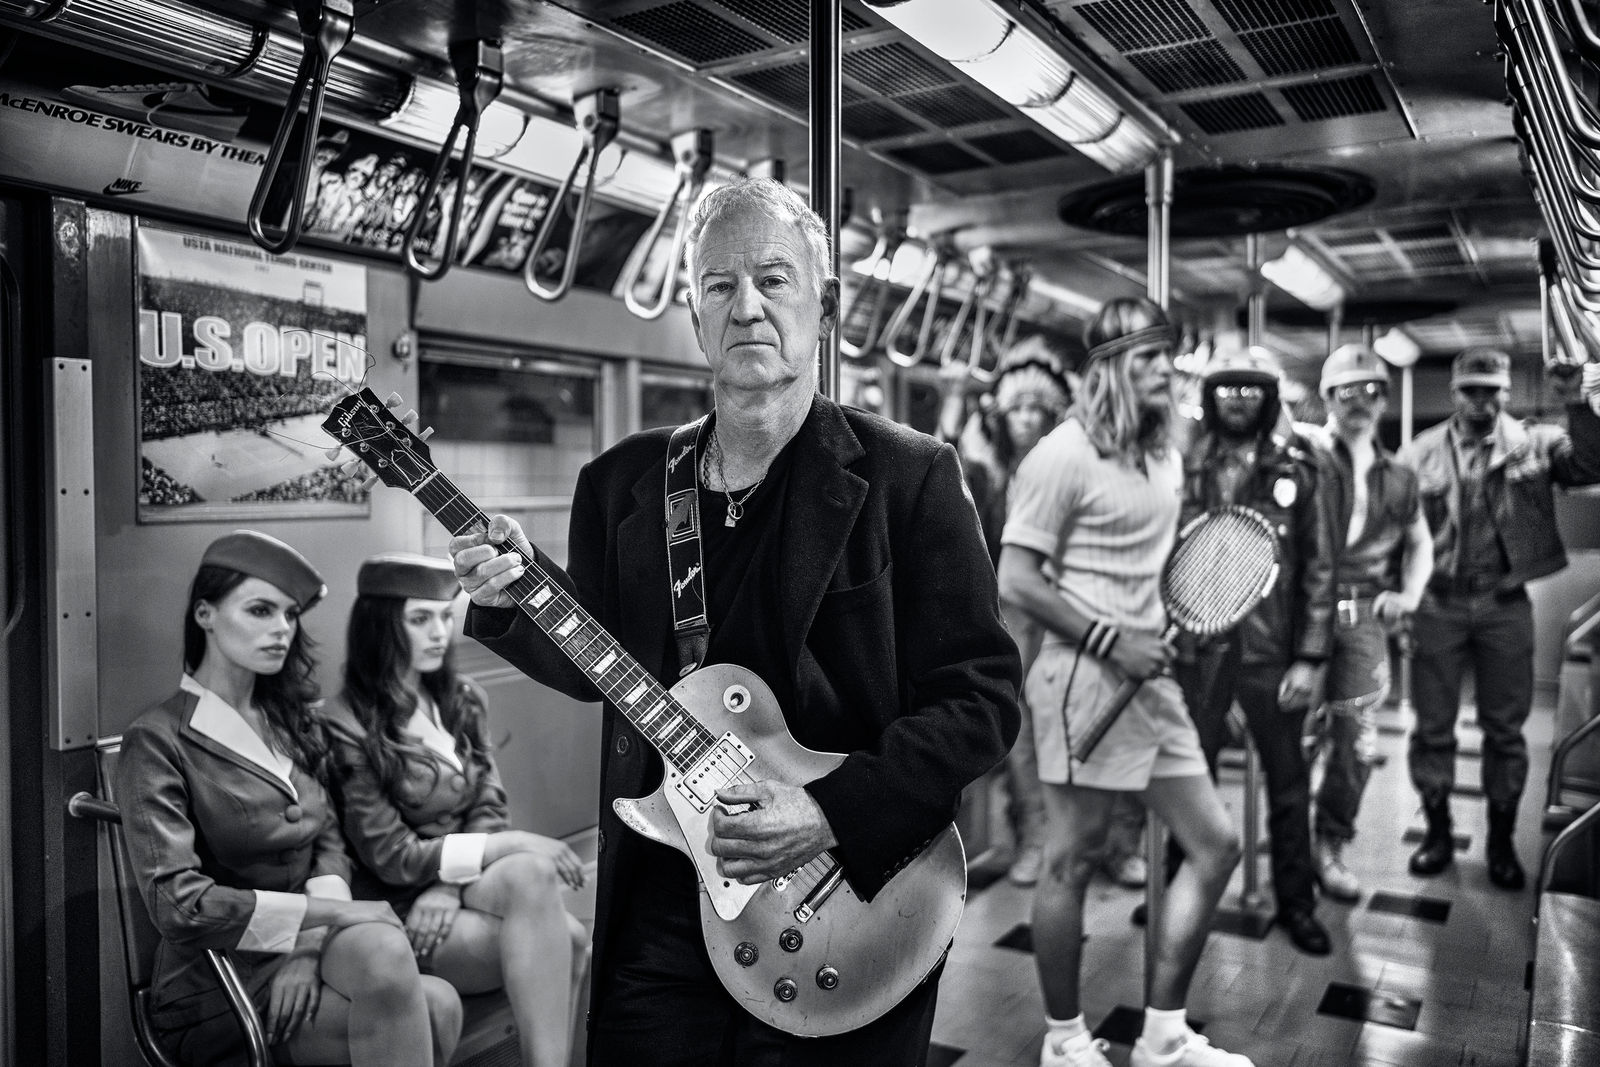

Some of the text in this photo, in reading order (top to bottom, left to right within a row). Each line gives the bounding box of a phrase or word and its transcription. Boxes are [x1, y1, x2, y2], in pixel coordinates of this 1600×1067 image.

[102, 117, 190, 147] SWEARS
[190, 136, 219, 155] BY
[112, 178, 142, 190] NIKE
[182, 237, 211, 252] USTA
[214, 242, 262, 261] NATIONAL
[299, 259, 332, 273] CENTER
[337, 399, 367, 428] Gibson
[668, 443, 695, 474] Fender
[673, 565, 701, 598] Fender
